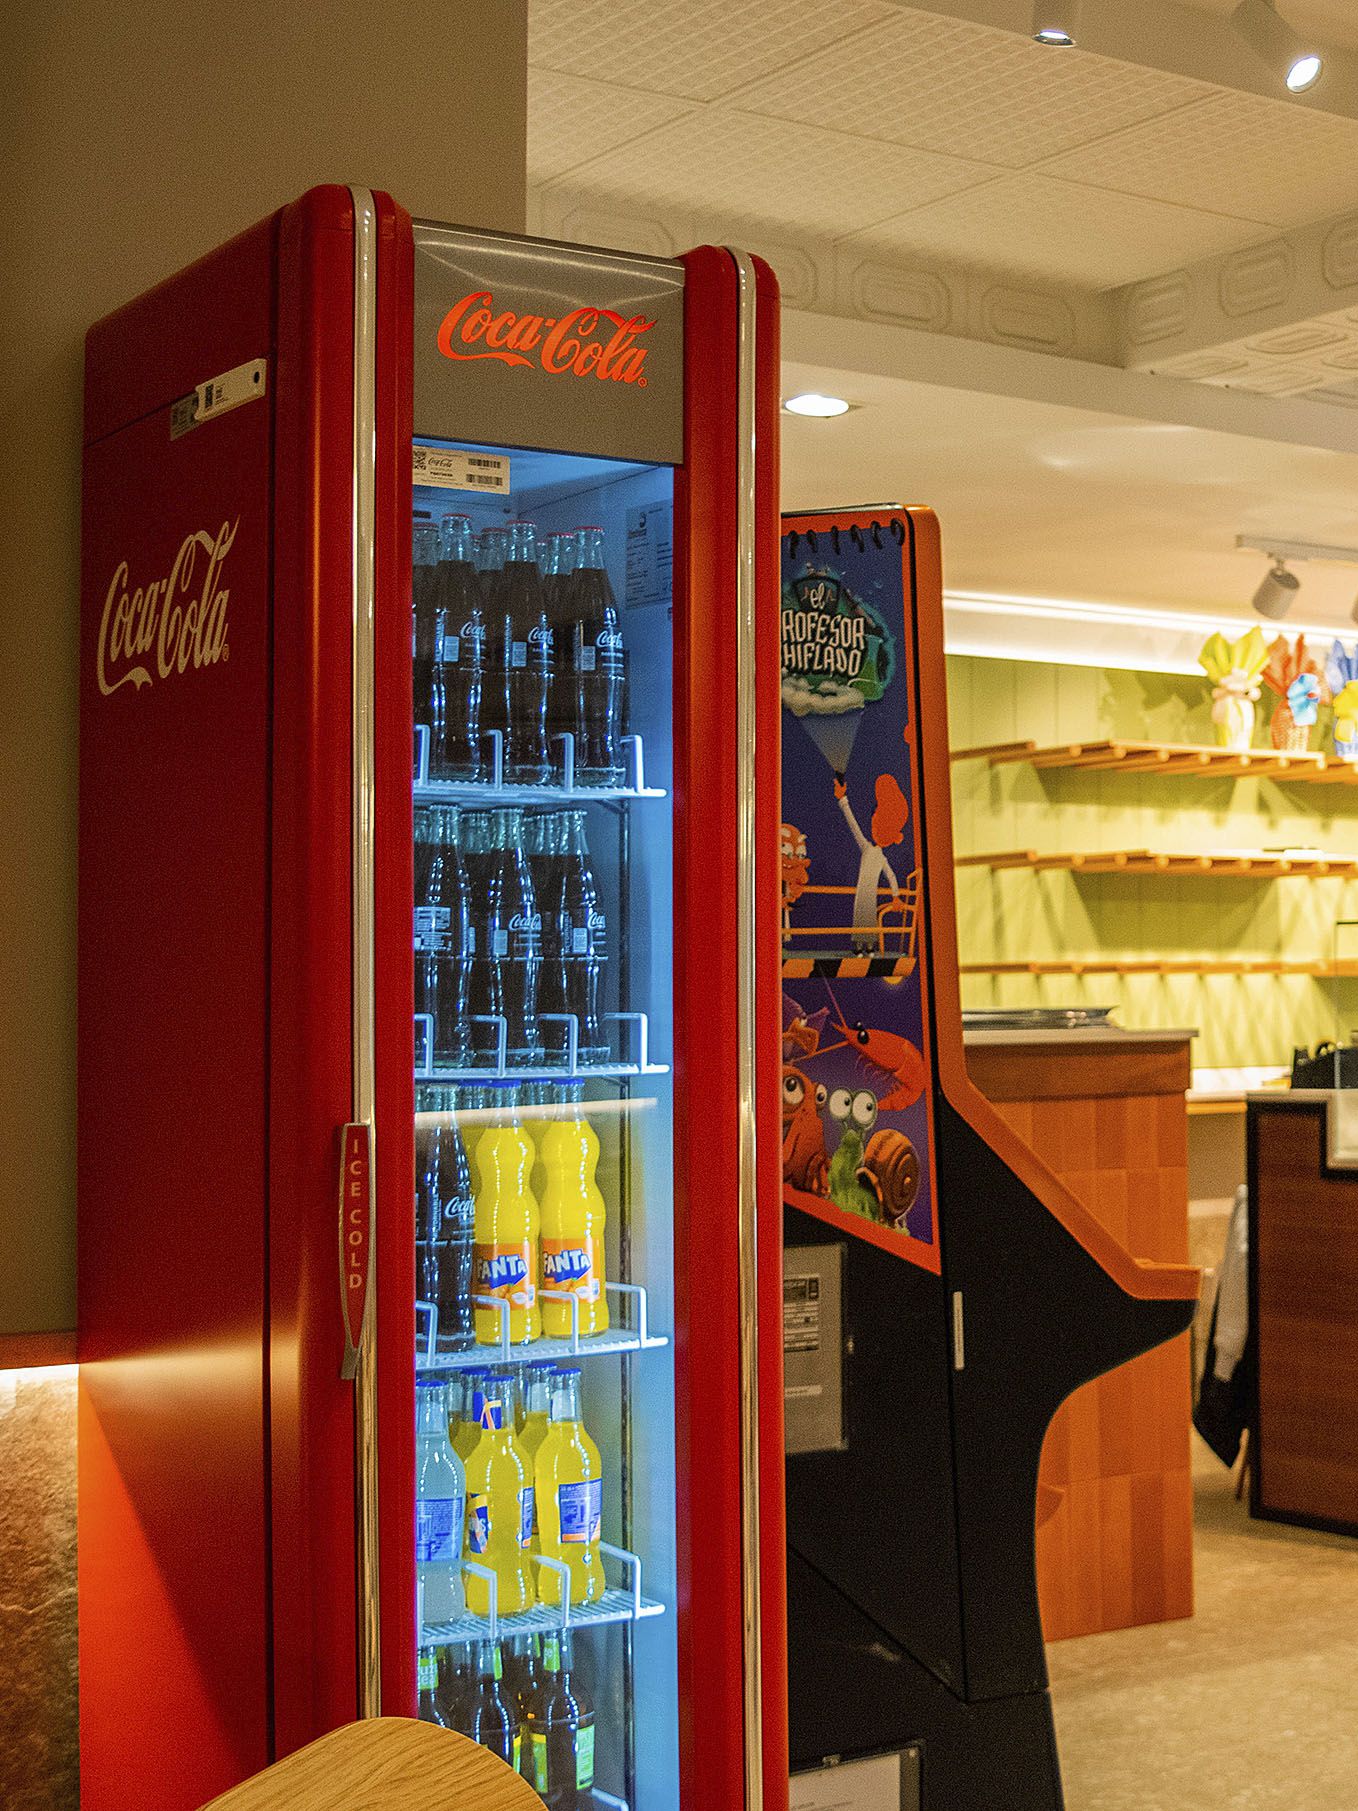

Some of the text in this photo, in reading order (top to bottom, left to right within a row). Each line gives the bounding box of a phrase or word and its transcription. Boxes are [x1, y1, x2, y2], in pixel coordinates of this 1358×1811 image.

[437, 291, 657, 388] Coca-Cola
[97, 513, 240, 696] Coca-Cola
[810, 582, 825, 609] el
[782, 609, 865, 650] ROFESOR
[783, 642, 862, 677] HIFLADO
[349, 1139, 363, 1289] ICE COLD
[477, 1255, 527, 1281] FANTA
[543, 1250, 591, 1275] FANTA
